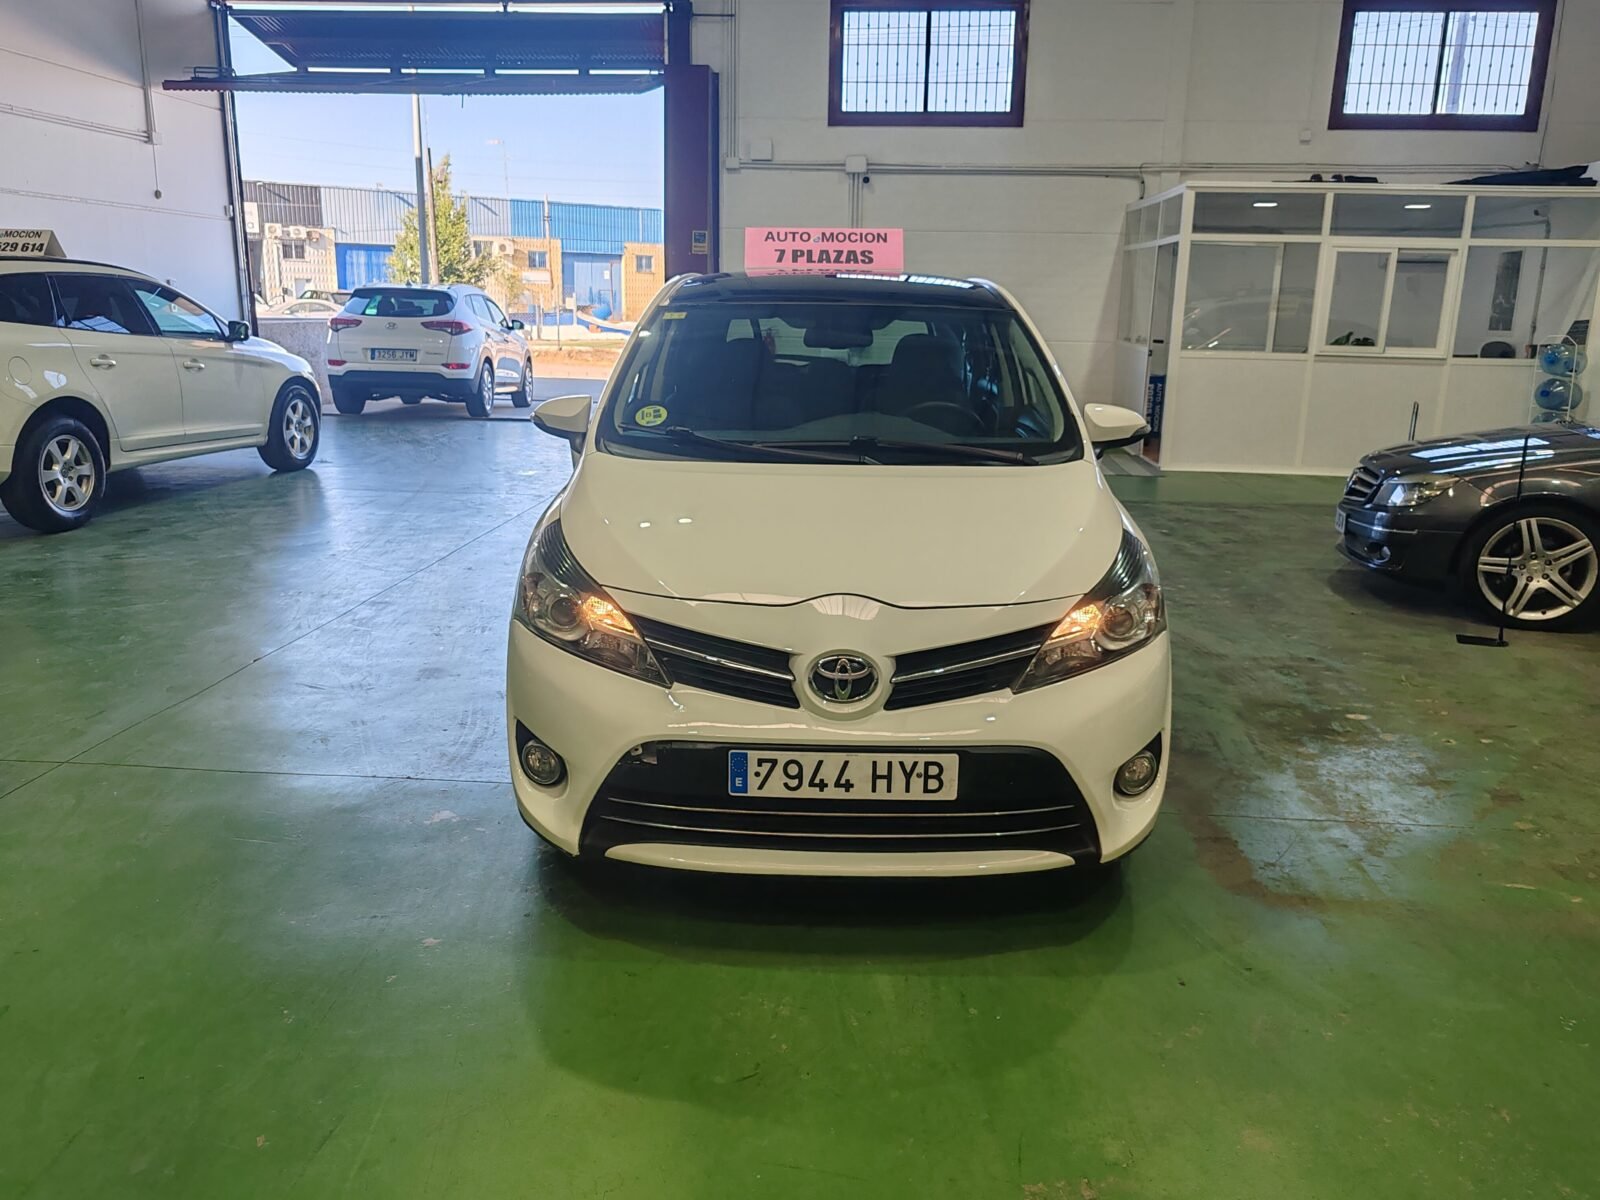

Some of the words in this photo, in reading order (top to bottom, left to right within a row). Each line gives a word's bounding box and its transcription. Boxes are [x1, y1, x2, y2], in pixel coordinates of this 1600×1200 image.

[764, 231, 812, 243] AUTO
[20, 242, 45, 252] 614
[774, 249, 786, 263] 7
[791, 249, 874, 265] PLAZAS
[756, 758, 855, 792] 7944
[871, 760, 945, 794] HYB
